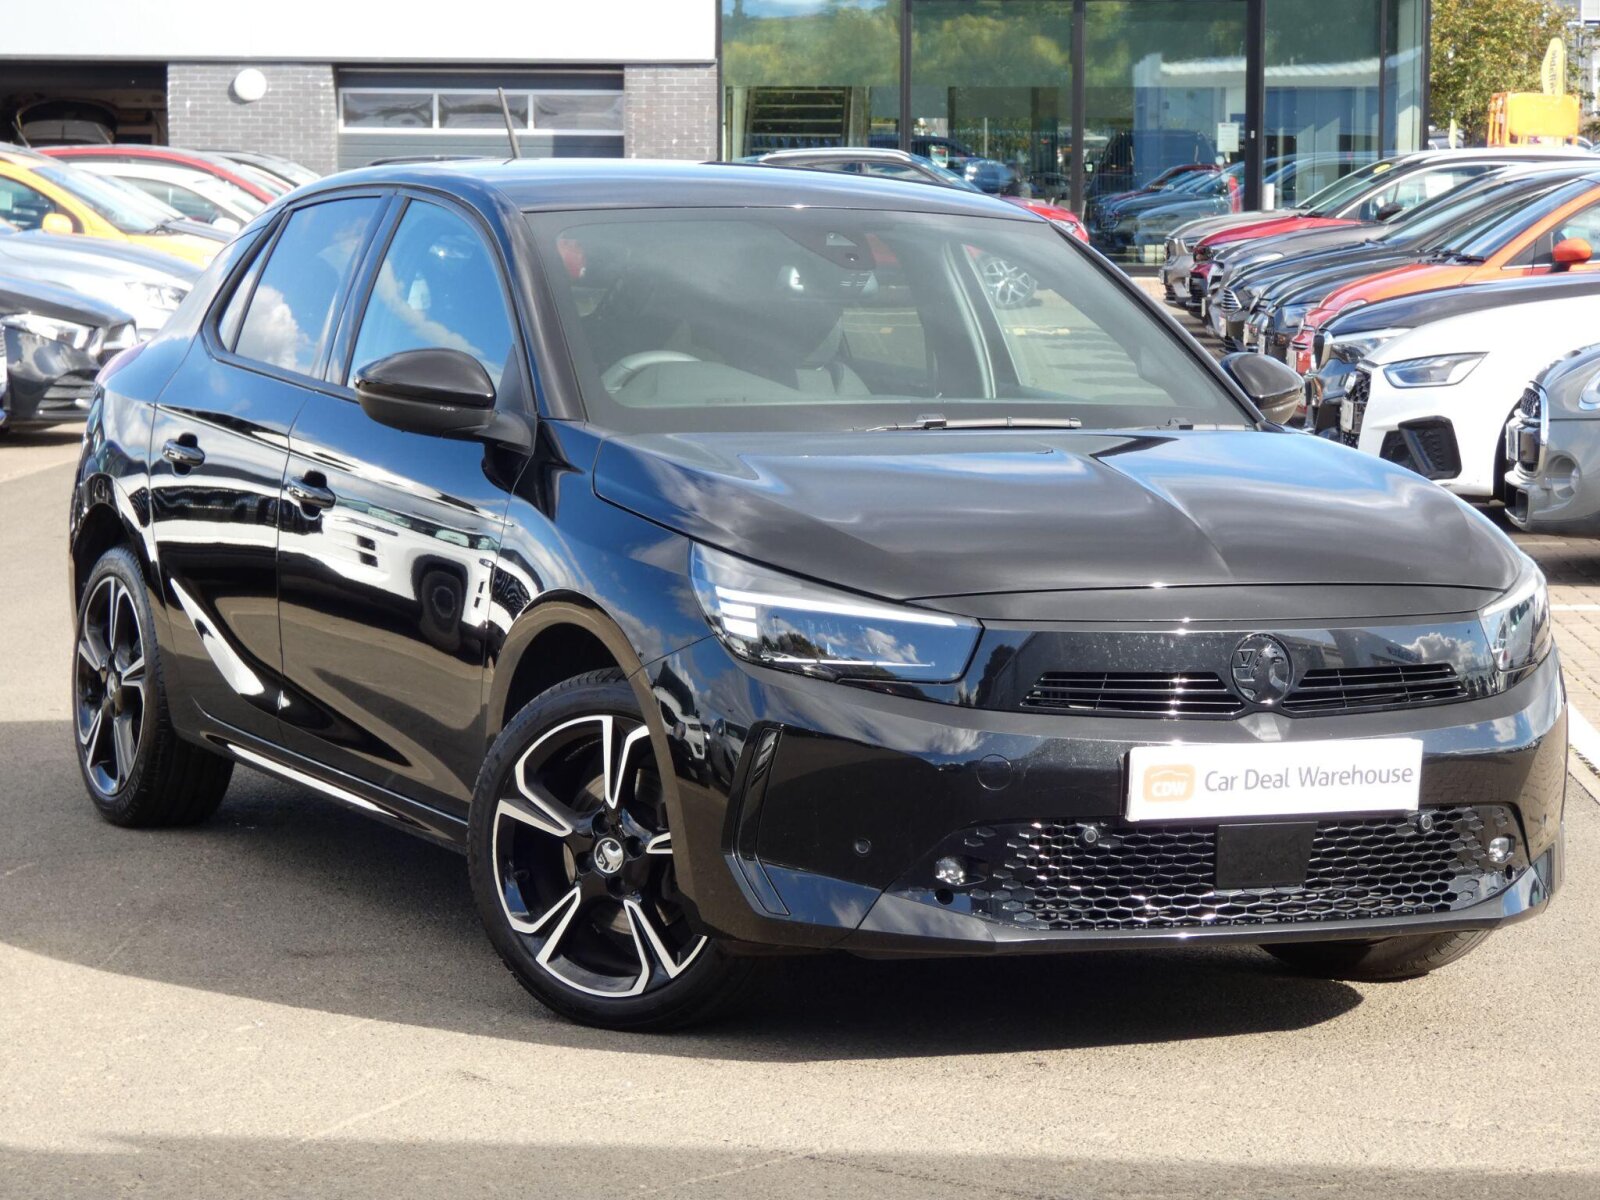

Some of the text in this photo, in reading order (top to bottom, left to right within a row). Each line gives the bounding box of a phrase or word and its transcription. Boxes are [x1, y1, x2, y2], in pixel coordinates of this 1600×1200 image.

[1204, 764, 1414, 792] Car Deal Warehouse
[1151, 781, 1187, 798] CDW
